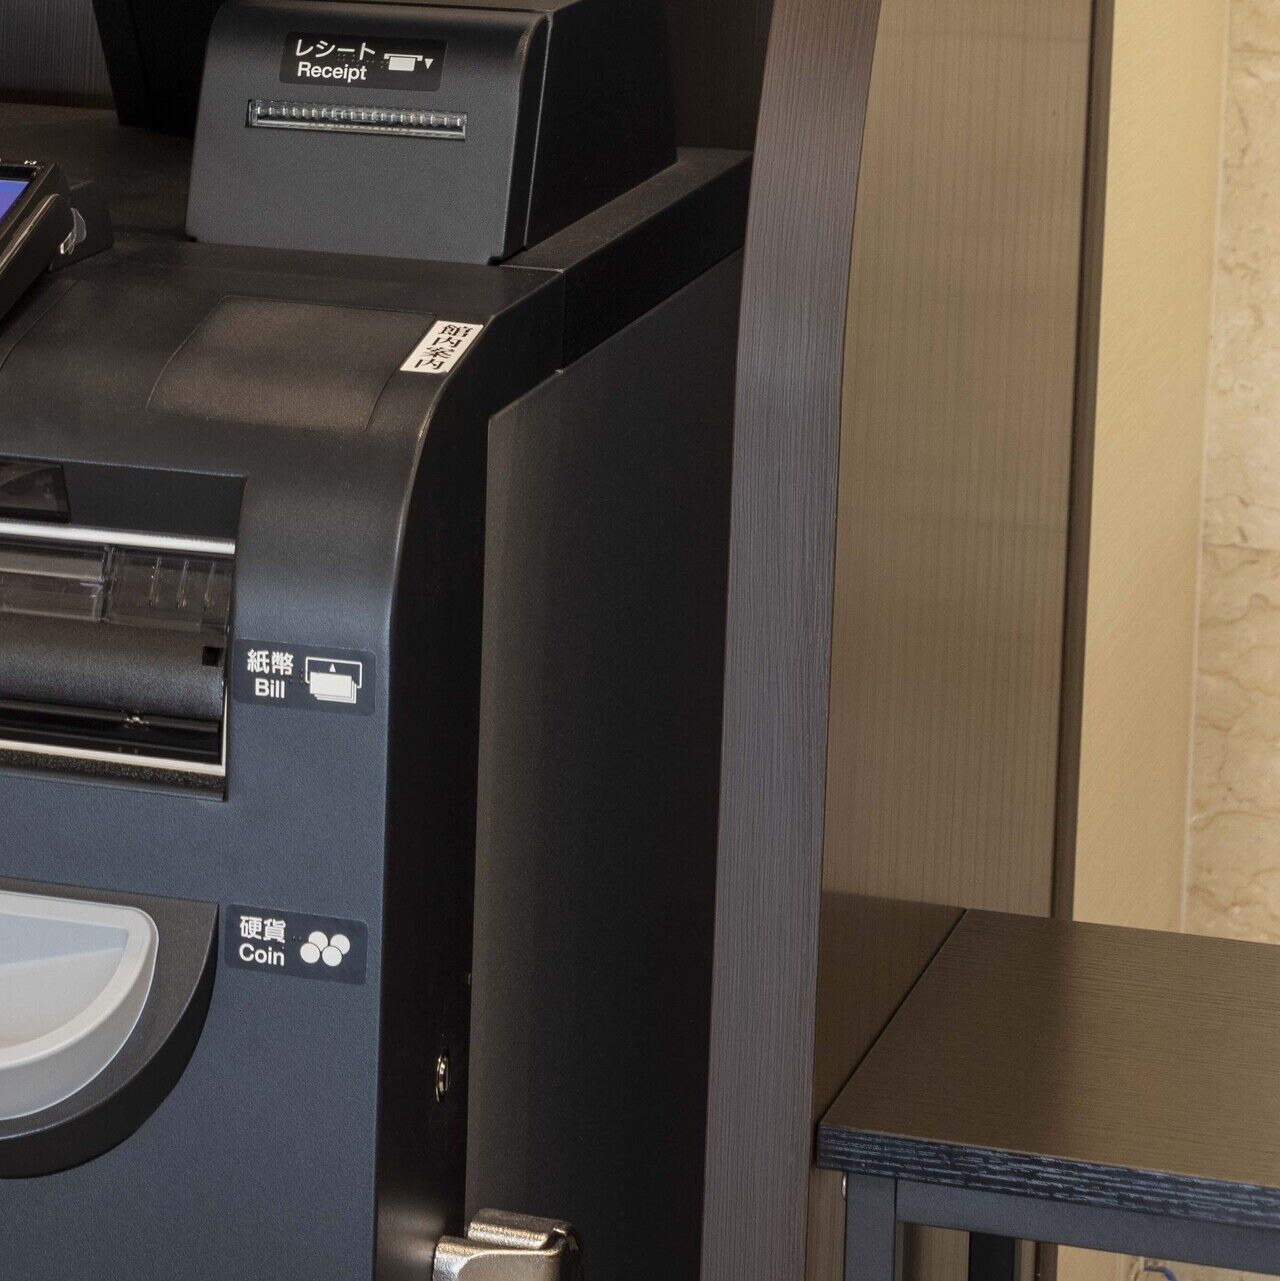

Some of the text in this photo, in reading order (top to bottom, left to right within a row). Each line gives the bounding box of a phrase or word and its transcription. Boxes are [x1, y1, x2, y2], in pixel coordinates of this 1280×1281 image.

[295, 38, 376, 61] レシート
[297, 61, 368, 83] Receipt
[247, 649, 294, 677] 紙幣
[255, 677, 286, 699] Bill
[239, 915, 287, 944] 硬貨
[238, 943, 286, 967] Coin
